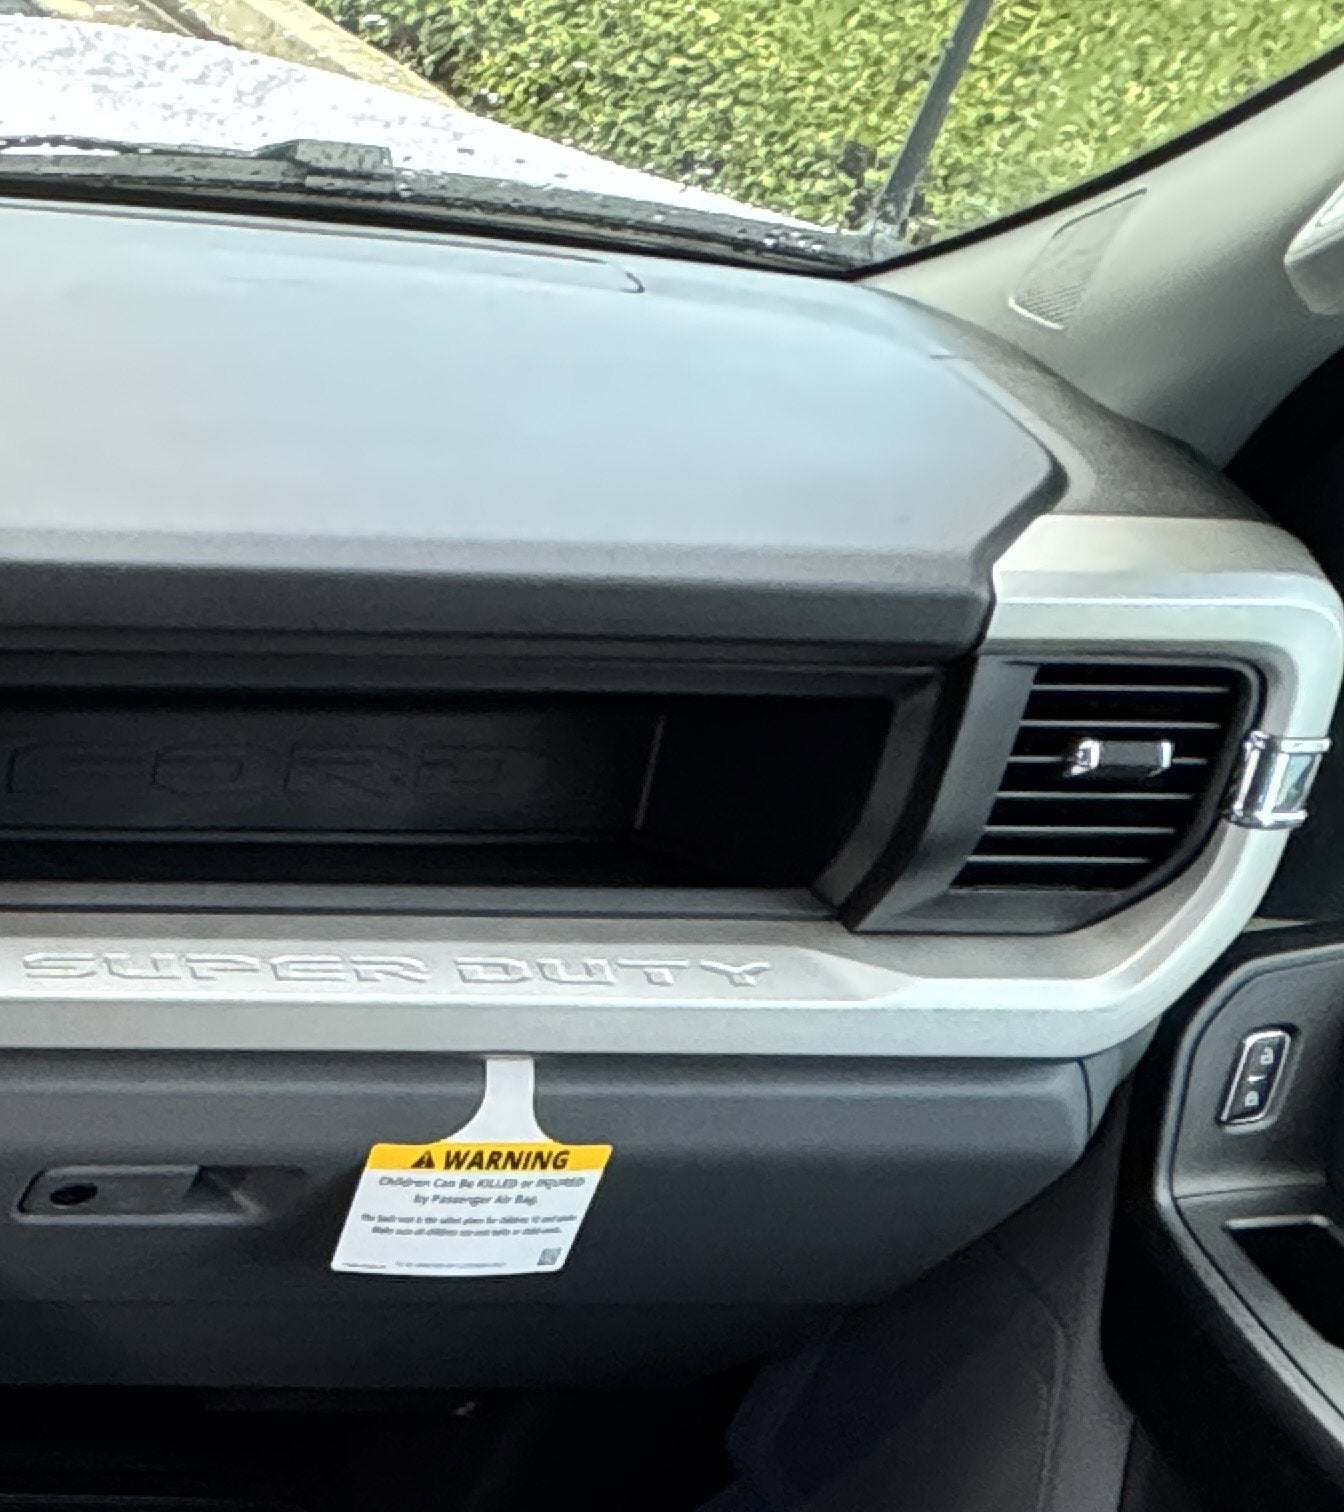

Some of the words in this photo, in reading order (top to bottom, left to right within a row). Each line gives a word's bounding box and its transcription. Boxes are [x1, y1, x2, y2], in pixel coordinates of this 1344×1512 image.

[23, 951, 433, 986] SUPER
[456, 955, 773, 990] DUTY
[443, 1150, 571, 1171] WARNING
[379, 1176, 431, 1188] Children
[433, 1177, 456, 1188] Can
[458, 1178, 475, 1189] Be
